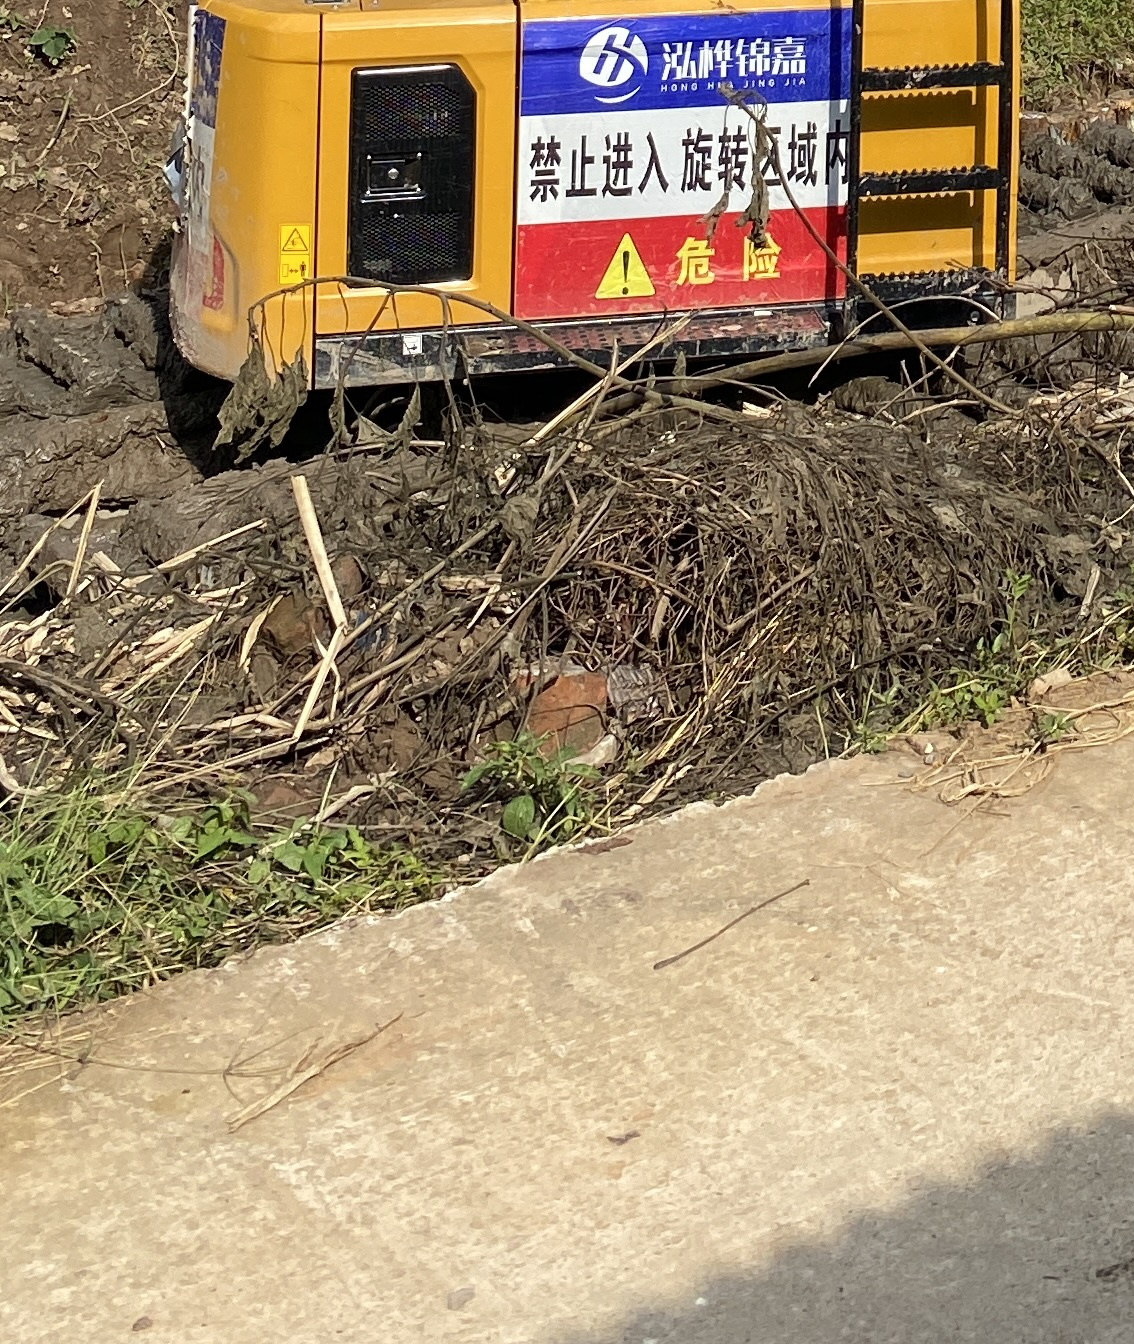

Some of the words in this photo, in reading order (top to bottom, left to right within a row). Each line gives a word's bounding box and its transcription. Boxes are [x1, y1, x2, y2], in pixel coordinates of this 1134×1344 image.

[661, 36, 807, 81] 泓桦锦嘉
[660, 82, 698, 92] HONG
[743, 79, 776, 89] JING
[784, 78, 806, 87] JIA
[676, 232, 782, 286] 危险
